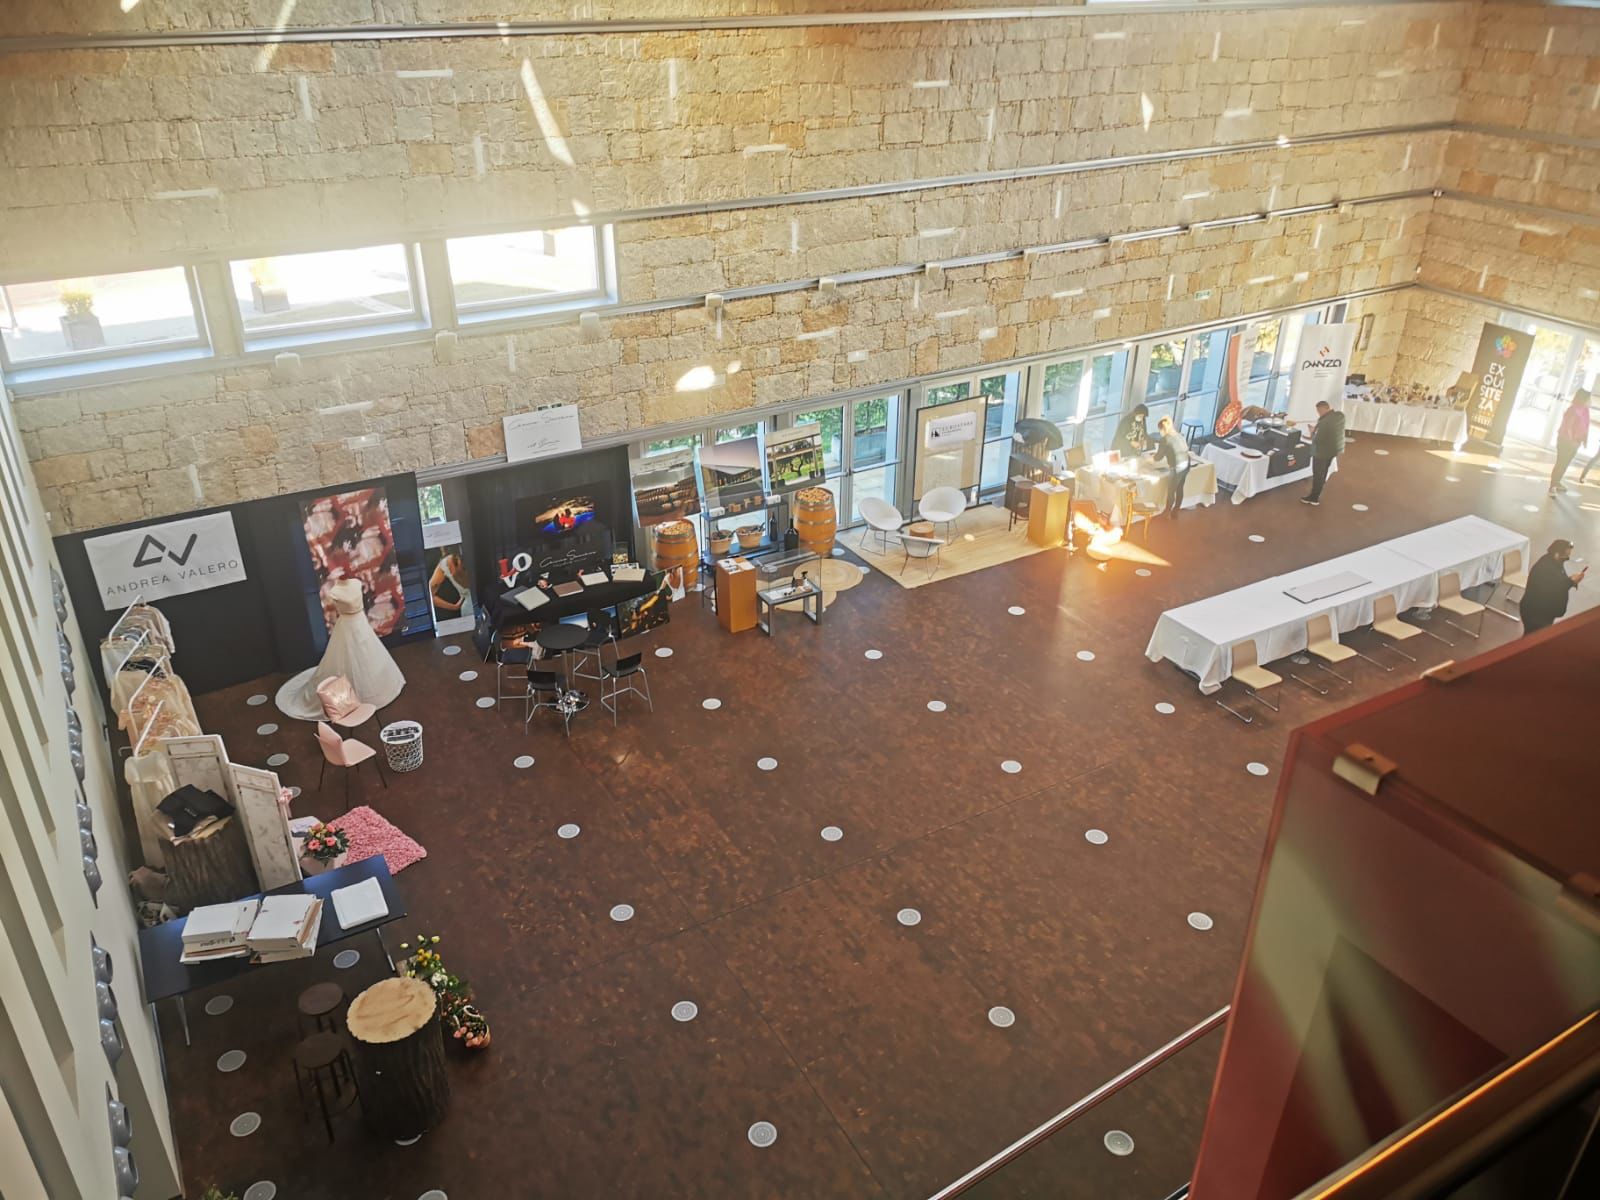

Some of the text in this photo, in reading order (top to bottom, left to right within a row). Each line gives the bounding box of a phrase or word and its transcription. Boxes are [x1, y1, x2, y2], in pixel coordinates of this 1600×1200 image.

[1489, 362, 1506, 377] EX
[1483, 374, 1505, 389] QUI
[1480, 385, 1503, 401] SITE
[1478, 398, 1493, 412] ZA
[106, 559, 238, 596] ANDREA VALERO
